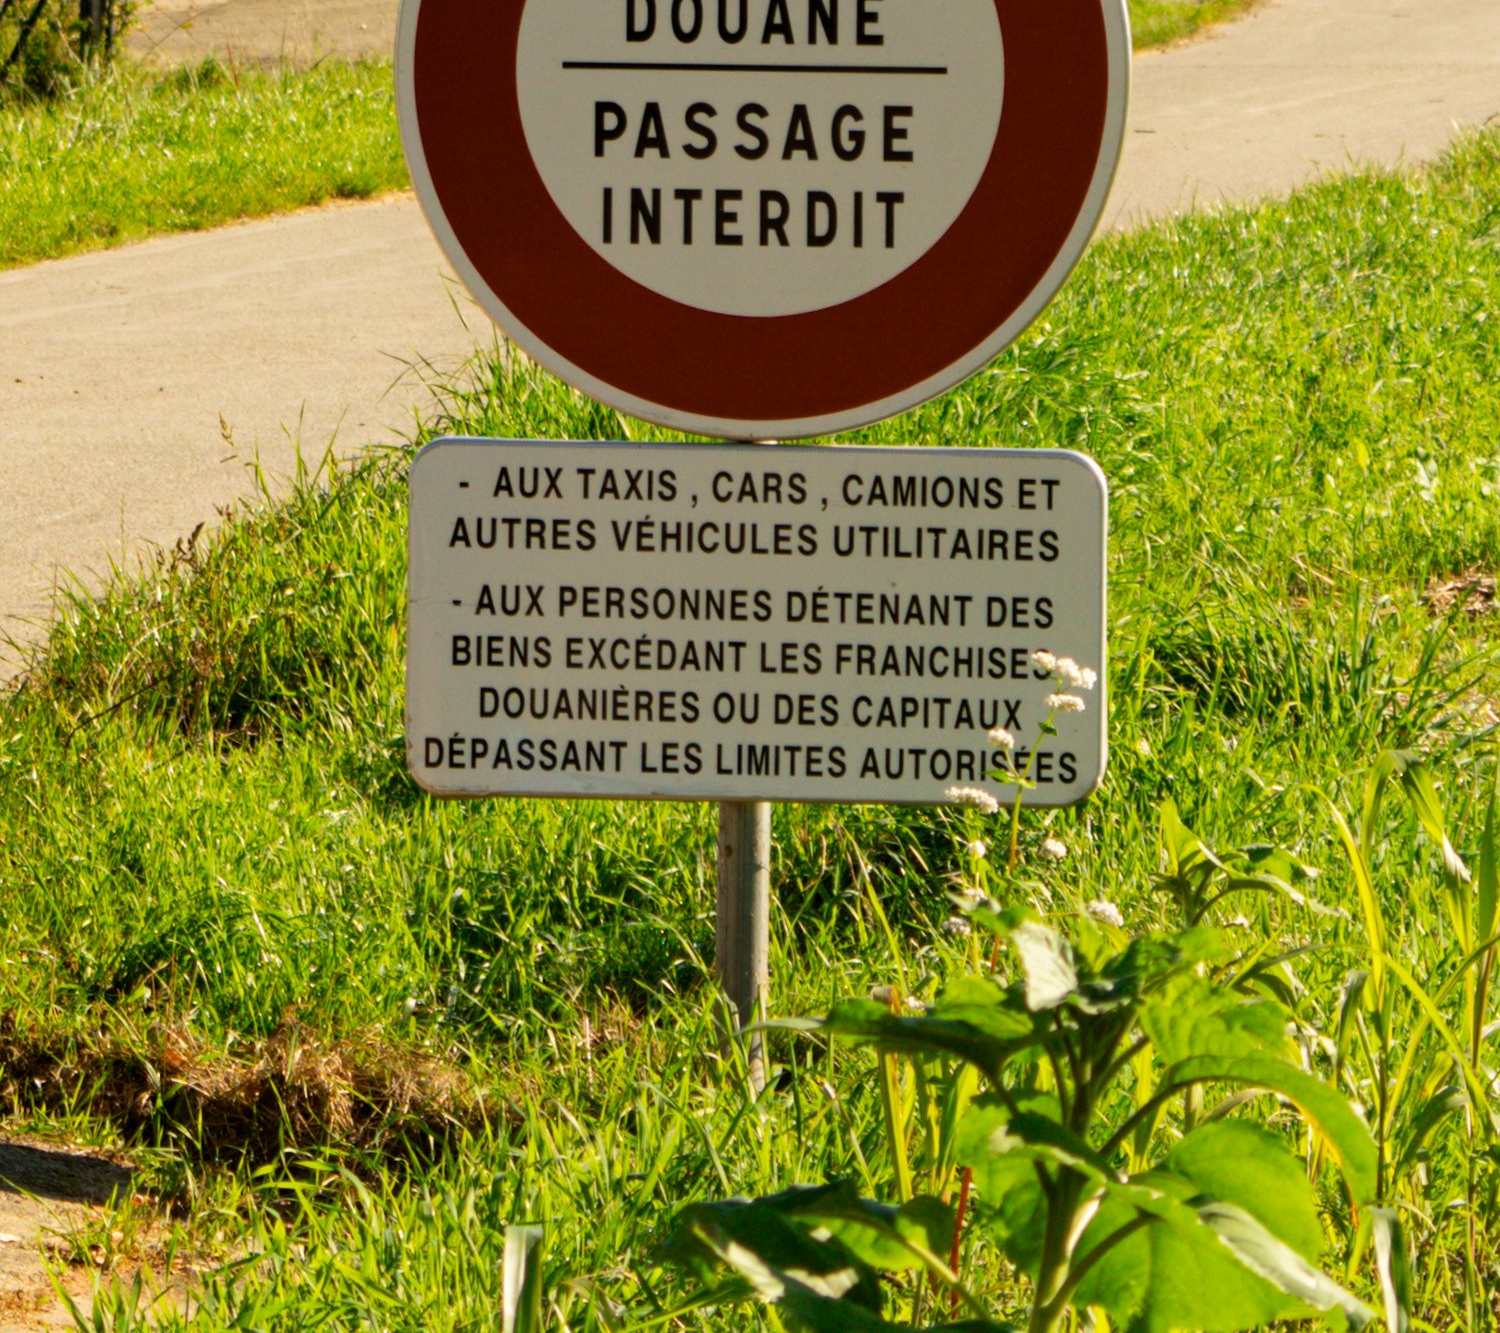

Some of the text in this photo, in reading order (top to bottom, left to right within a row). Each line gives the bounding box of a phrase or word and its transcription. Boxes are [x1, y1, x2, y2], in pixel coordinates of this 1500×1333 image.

[595, 101, 914, 162] PASSAGE
[603, 188, 904, 248] INTERDIT
[493, 467, 563, 498] AUX
[843, 474, 1004, 509] CAMIONS
[1019, 479, 1060, 510] ET
[449, 515, 1059, 562] AUTRES VÉHICULES UTILITAIRES
[475, 585, 544, 616] AUX
[559, 586, 772, 622] PERSONNES
[787, 586, 973, 627] DÉTENANT
[987, 596, 1054, 629] DES
[452, 635, 551, 668] BIENS
[566, 634, 746, 672] EXCÉDANT
[761, 642, 822, 674] LES
[480, 685, 1022, 731] DOUANIÈRES OU DES CAPITAUX
[425, 732, 627, 772] DÉPASSANT
[641, 742, 702, 774] LES
[717, 744, 846, 778] LIMITES
